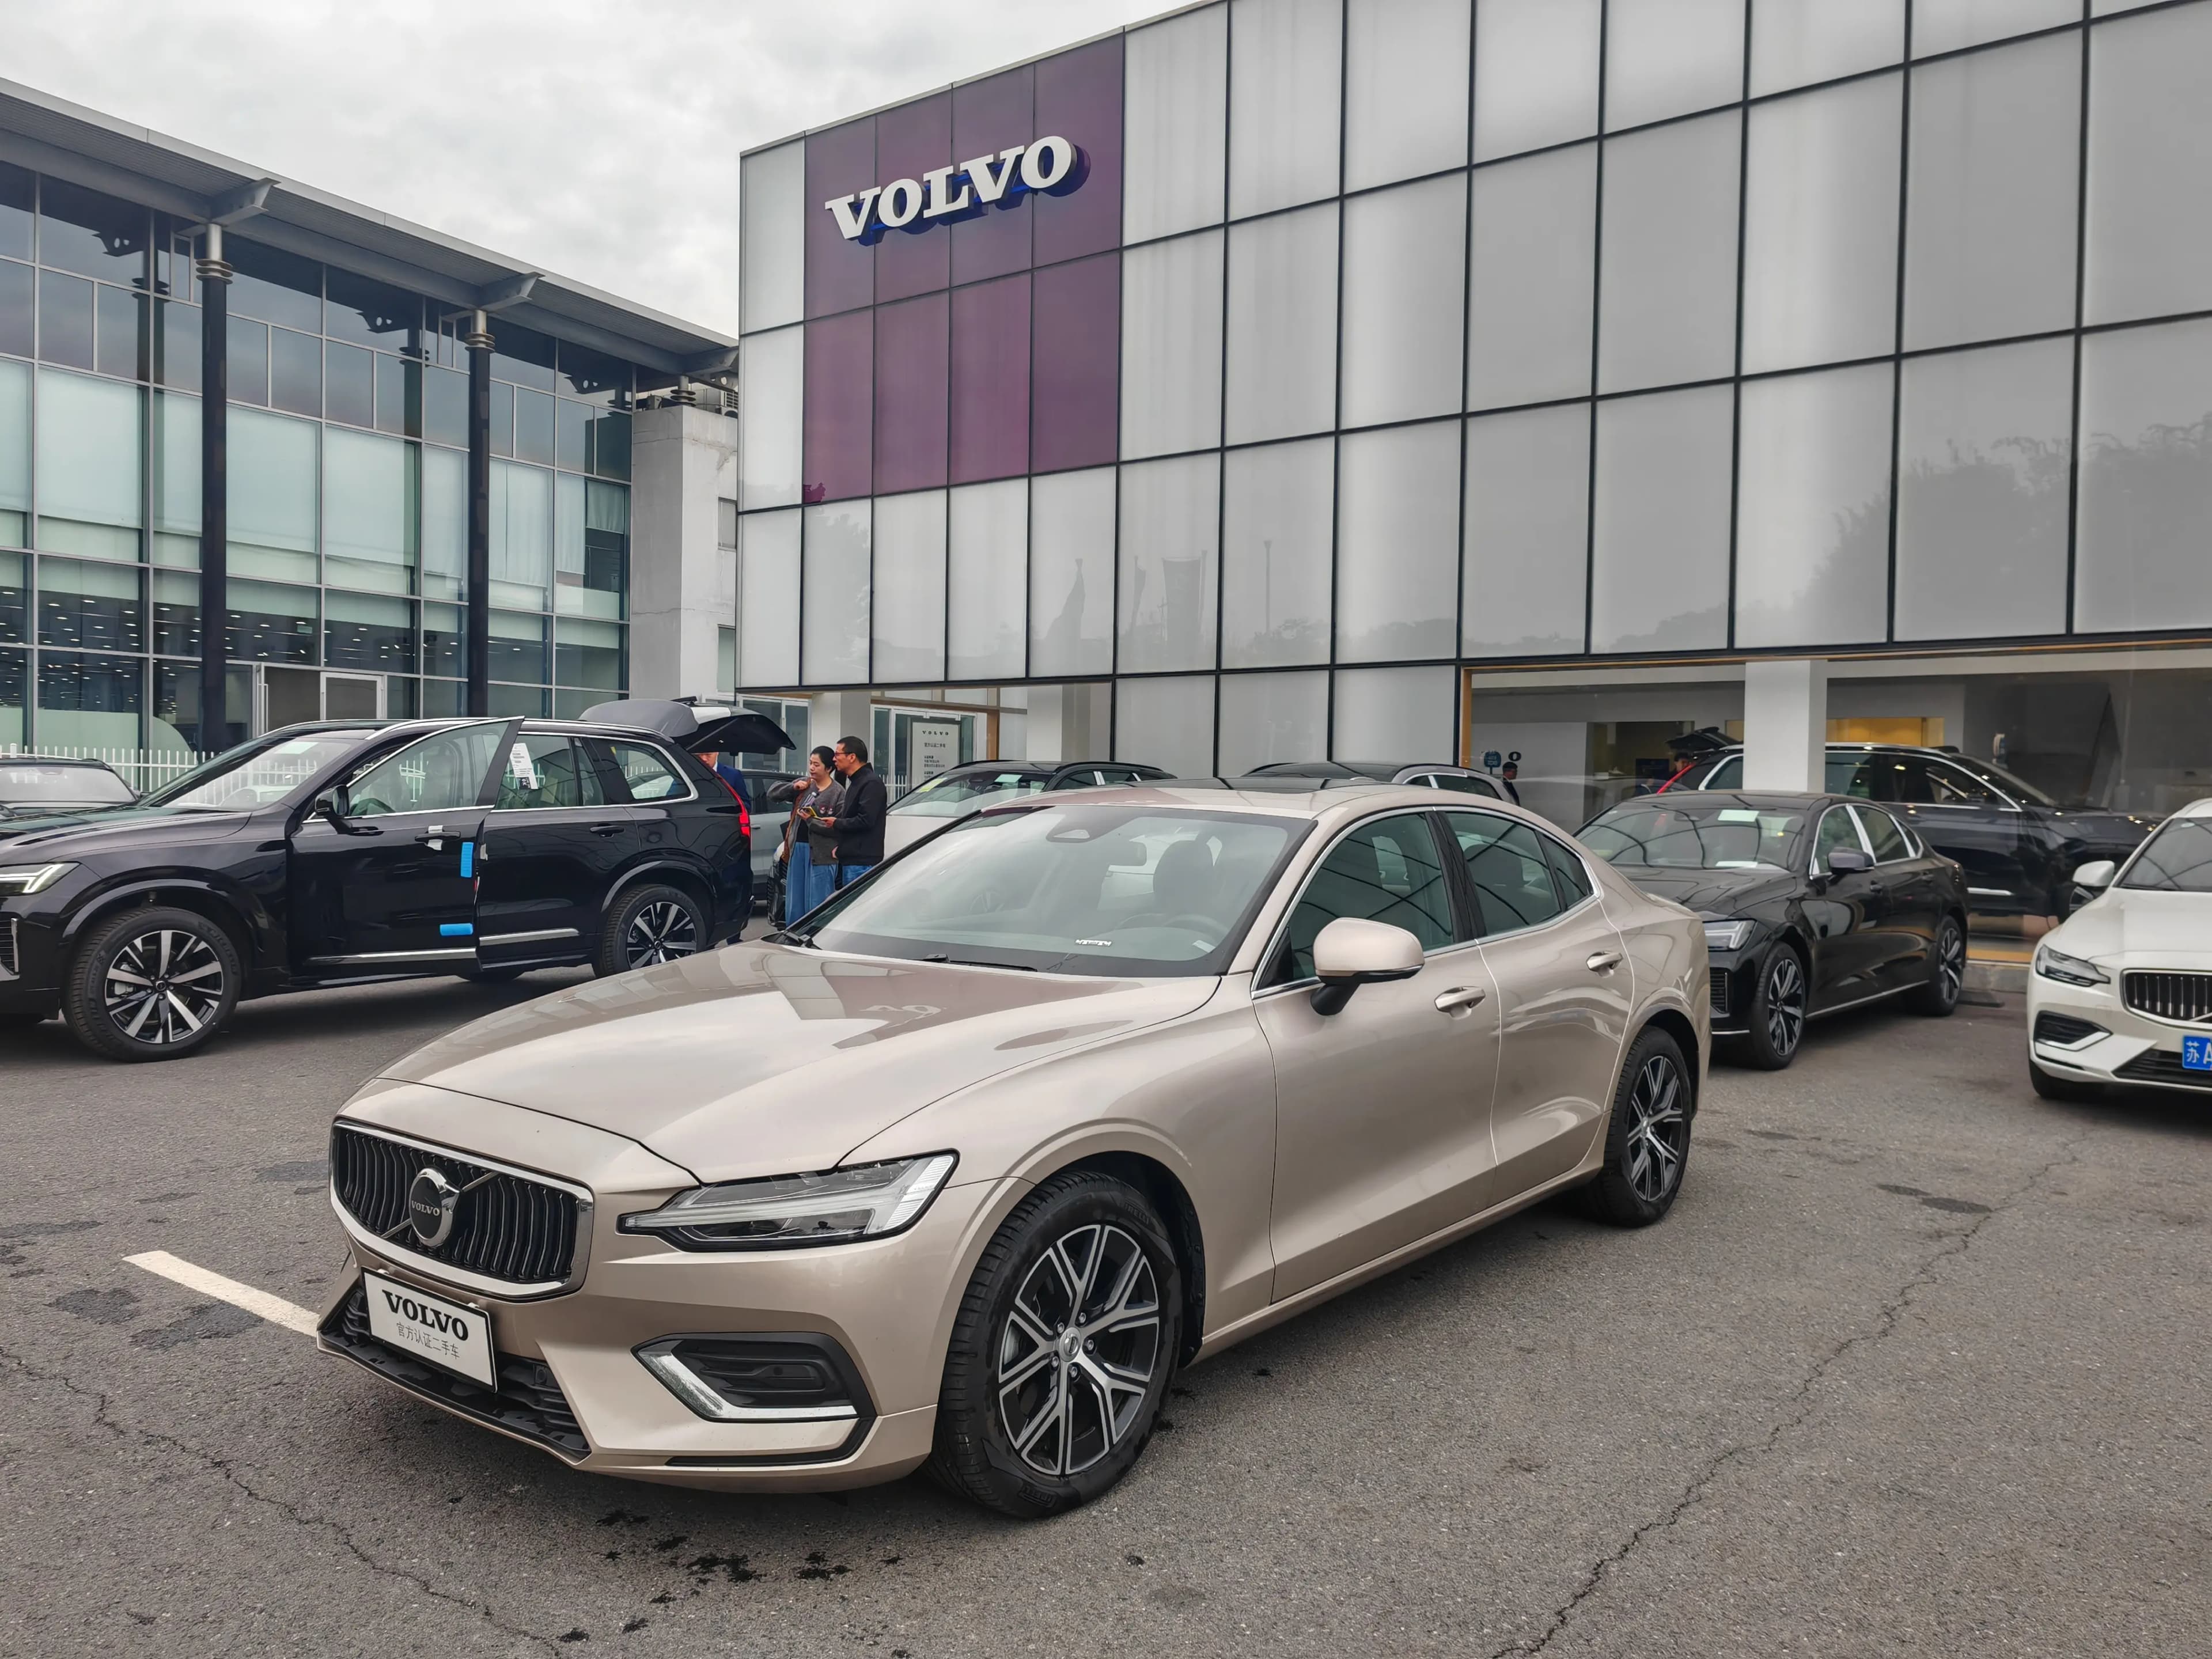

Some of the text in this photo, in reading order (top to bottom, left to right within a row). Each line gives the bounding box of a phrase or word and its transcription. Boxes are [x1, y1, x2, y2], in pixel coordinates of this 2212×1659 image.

[825, 135, 1075, 240] VOLVO
[411, 1200, 440, 1216] VOLVO
[382, 1289, 469, 1341] VOLVO
[396, 1321, 460, 1359] 官方认证二手车
